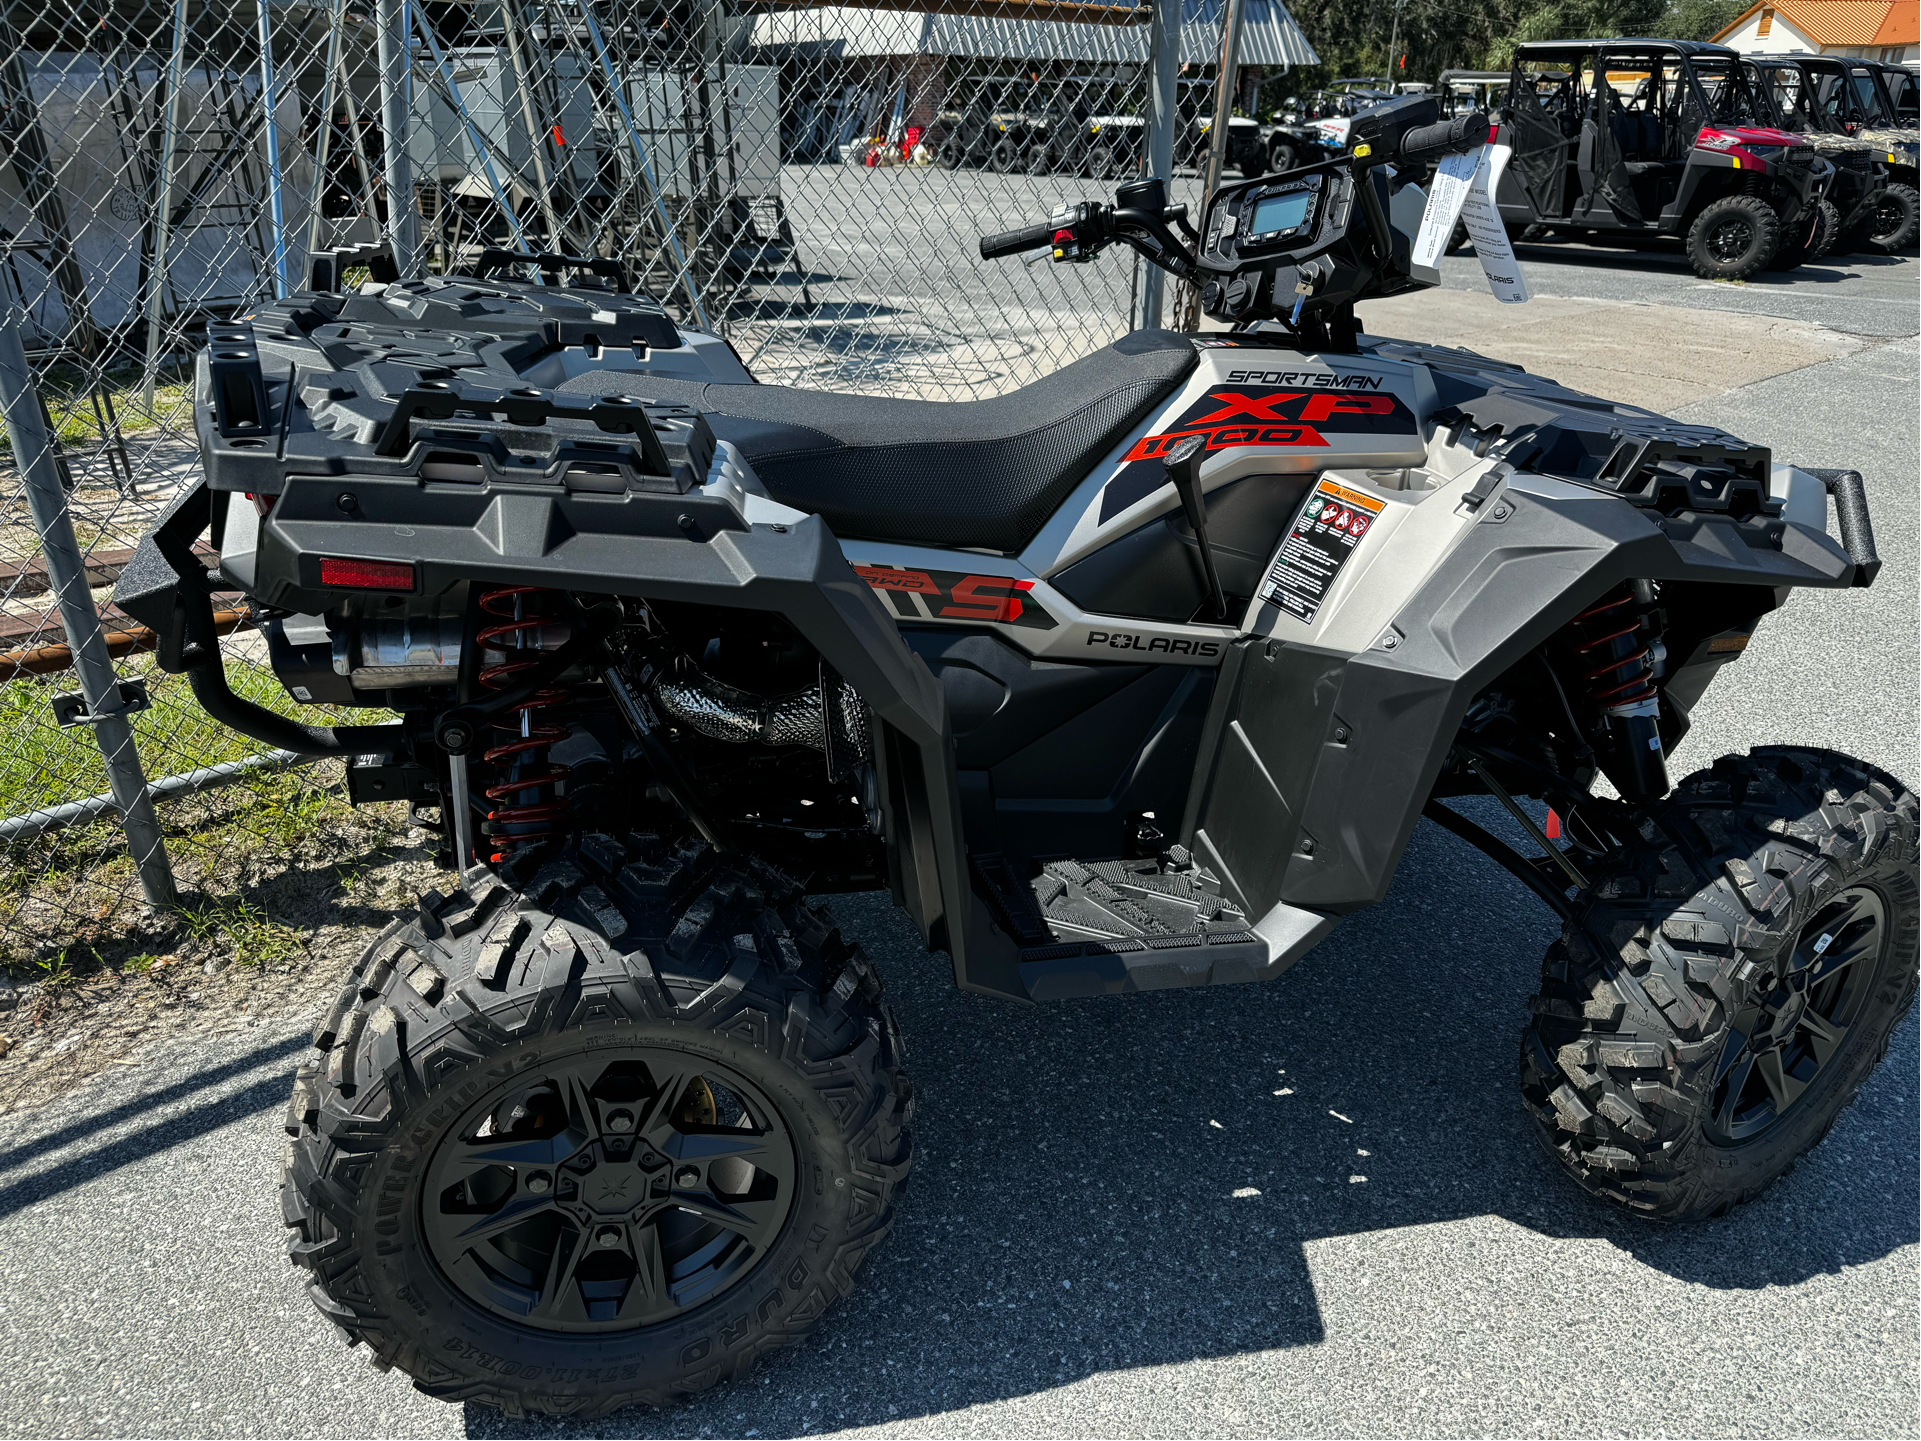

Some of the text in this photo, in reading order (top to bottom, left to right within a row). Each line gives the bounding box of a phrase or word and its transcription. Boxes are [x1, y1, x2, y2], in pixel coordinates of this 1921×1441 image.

[1226, 370, 1384, 390] SPORTSMAN
[1184, 393, 1396, 426] XP
[1341, 490, 1366, 504] WARNING
[939, 574, 1036, 623] S
[1086, 630, 1221, 658] POLARIS
[485, 1051, 539, 1078] V2
[680, 1255, 812, 1365] DURO
